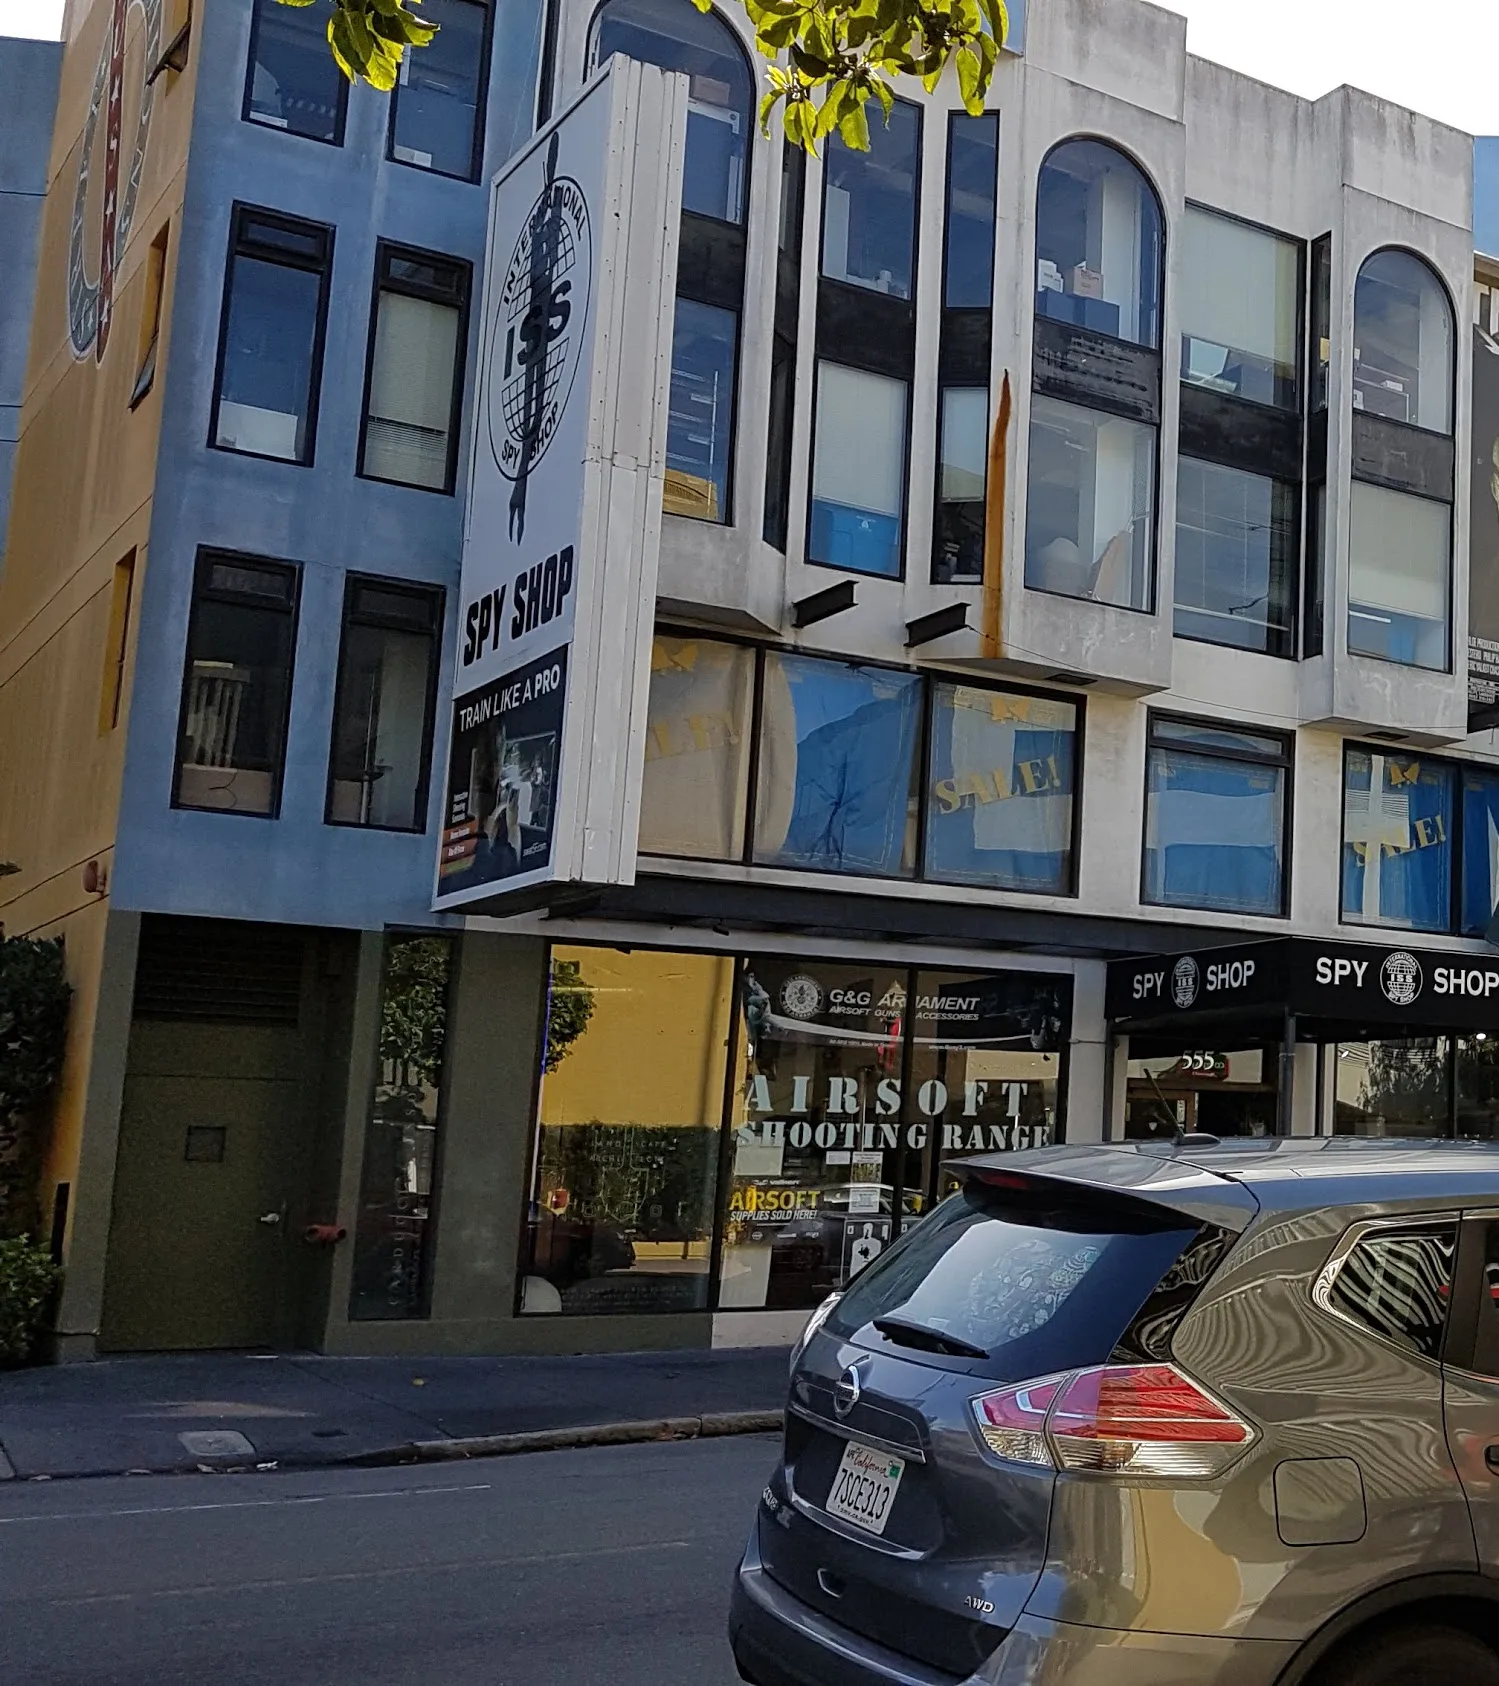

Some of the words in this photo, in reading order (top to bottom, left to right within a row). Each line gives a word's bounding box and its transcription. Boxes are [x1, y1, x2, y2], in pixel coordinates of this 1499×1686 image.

[501, 438, 521, 465] SPY
[463, 583, 506, 667] SPY
[511, 545, 574, 640] SHOP
[460, 696, 491, 733] TRAIN
[493, 684, 520, 717] LIKE
[522, 682, 532, 702] A
[533, 662, 561, 700] PRO
[935, 754, 1061, 815] SALE!
[1132, 972, 1165, 999] SPY
[1206, 960, 1256, 991] SHOP
[1315, 956, 1369, 987] SPY
[1390, 973, 1413, 983] ISS
[1433, 967, 1499, 997] SHOP
[828, 1005, 870, 1016] AIRSOFT
[874, 1008, 901, 1018] GUNS
[916, 1012, 980, 1021] ACCESSORIES
[829, 988, 872, 1006] G&G
[878, 993, 981, 1011] ARAMENT
[1182, 1051, 1215, 1070] 555
[743, 1074, 1028, 1118] AIRSOFT
[736, 1120, 928, 1150] SHOOTING
[941, 1124, 1050, 1150] RANGE
[729, 1190, 821, 1211] AIRSOFT
[730, 1210, 770, 1221] SUPPLIES
[771, 1209, 793, 1220] SOLD
[793, 1209, 818, 1220] HERE!
[853, 1448, 889, 1478] California
[834, 1467, 890, 1520] 7SCE313
[964, 1595, 994, 1613] AWD
